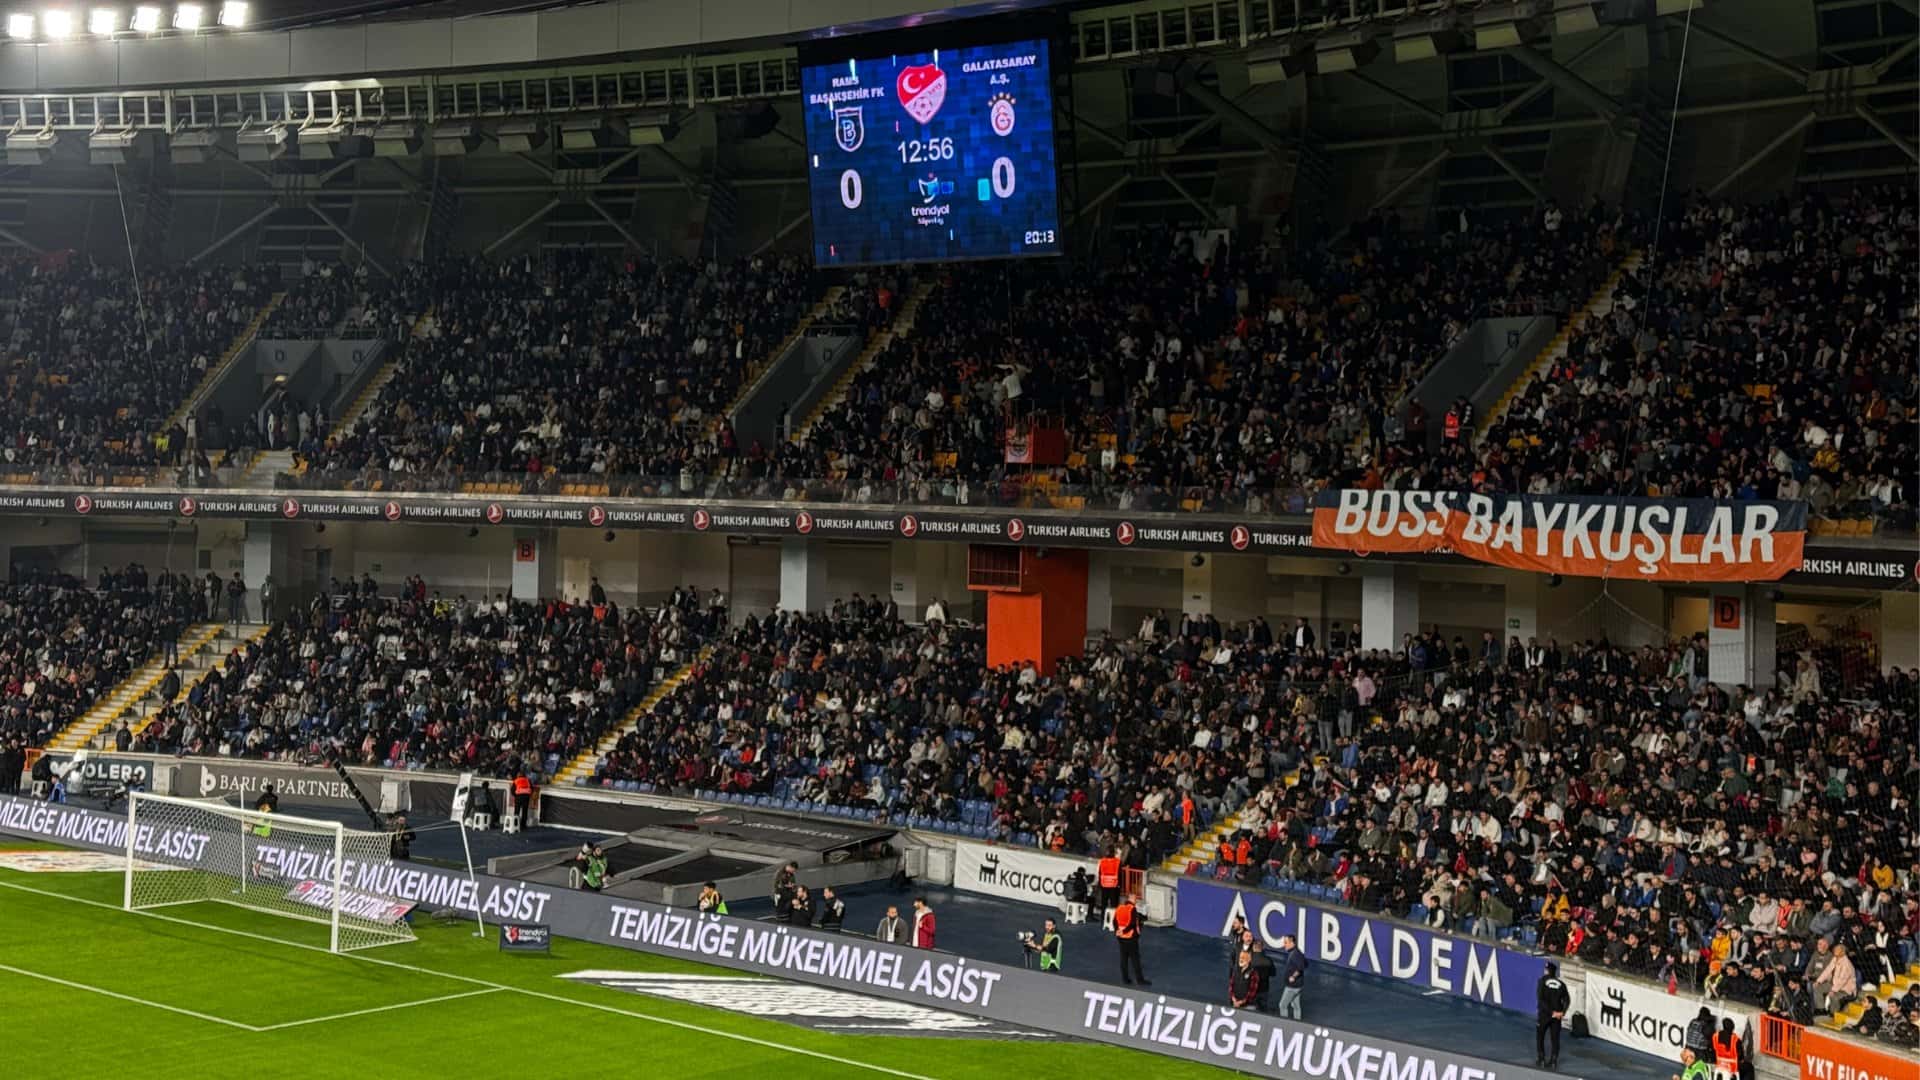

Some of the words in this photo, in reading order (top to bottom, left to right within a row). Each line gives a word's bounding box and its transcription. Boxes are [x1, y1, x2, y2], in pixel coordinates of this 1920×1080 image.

[962, 55, 1036, 72] GALATASARAY
[871, 87, 884, 98] FK
[898, 137, 954, 163] 12:56
[992, 156, 1015, 198] 0
[840, 169, 862, 209] 0
[911, 204, 950, 217] trendyol
[0, 497, 24, 507] KISH
[26, 497, 65, 508] AIRLINES
[95, 500, 133, 509] TURKISH
[135, 501, 173, 511] AIRLINES
[200, 502, 236, 512] TURKISH
[239, 503, 277, 513] AIRLINES
[303, 504, 339, 514] TURKISH
[341, 505, 379, 515] AIRLINES
[405, 506, 441, 516] TURKISH
[443, 507, 481, 517] AIRLINES
[506, 509, 542, 519] TURKISH
[544, 510, 582, 520] AIRLINES
[608, 511, 644, 521] TURKISH
[647, 512, 685, 523] AIRLINES
[713, 516, 749, 526] TURKISH
[752, 517, 790, 528] AIRLINES
[816, 518, 853, 529] TURKISH
[856, 519, 894, 531] AIRLINES
[921, 521, 958, 532] TURKISH
[961, 522, 1001, 534] AIRLINES
[1028, 525, 1067, 537] TURKISH
[1070, 526, 1110, 538] AIRLINES
[1139, 529, 1179, 541] TURKISH
[1182, 531, 1224, 543] AIRLINES
[1335, 488, 1458, 538] BOSS
[1462, 494, 1779, 574] BAYKUŞLAR
[1253, 533, 1295, 546] TURKISH
[1796, 559, 1842, 574] RKISH
[1846, 561, 1905, 577] AIRLINES
[1720, 601, 1735, 623] D
[85, 763, 146, 783] OLERO
[219, 775, 256, 792] BARI
[276, 779, 357, 799] PARTNER
[0, 797, 58, 834] MİZLİĞE
[55, 808, 153, 853] MÜKEMMEL
[156, 826, 210, 861] ASİST
[354, 860, 480, 912] MÜKEMMEL
[482, 881, 551, 923] ASİST
[1222, 891, 1503, 1004] ACIBADEM
[610, 904, 739, 958] TEMİZLİĞE
[739, 926, 905, 990] MÜKEMMEL
[909, 957, 1001, 1007] ASİST
[1084, 991, 1261, 1062] TEMİZLİĞE
[1264, 1027, 1496, 1080] MÜKEMM
[1628, 1010, 1685, 1048] kara
